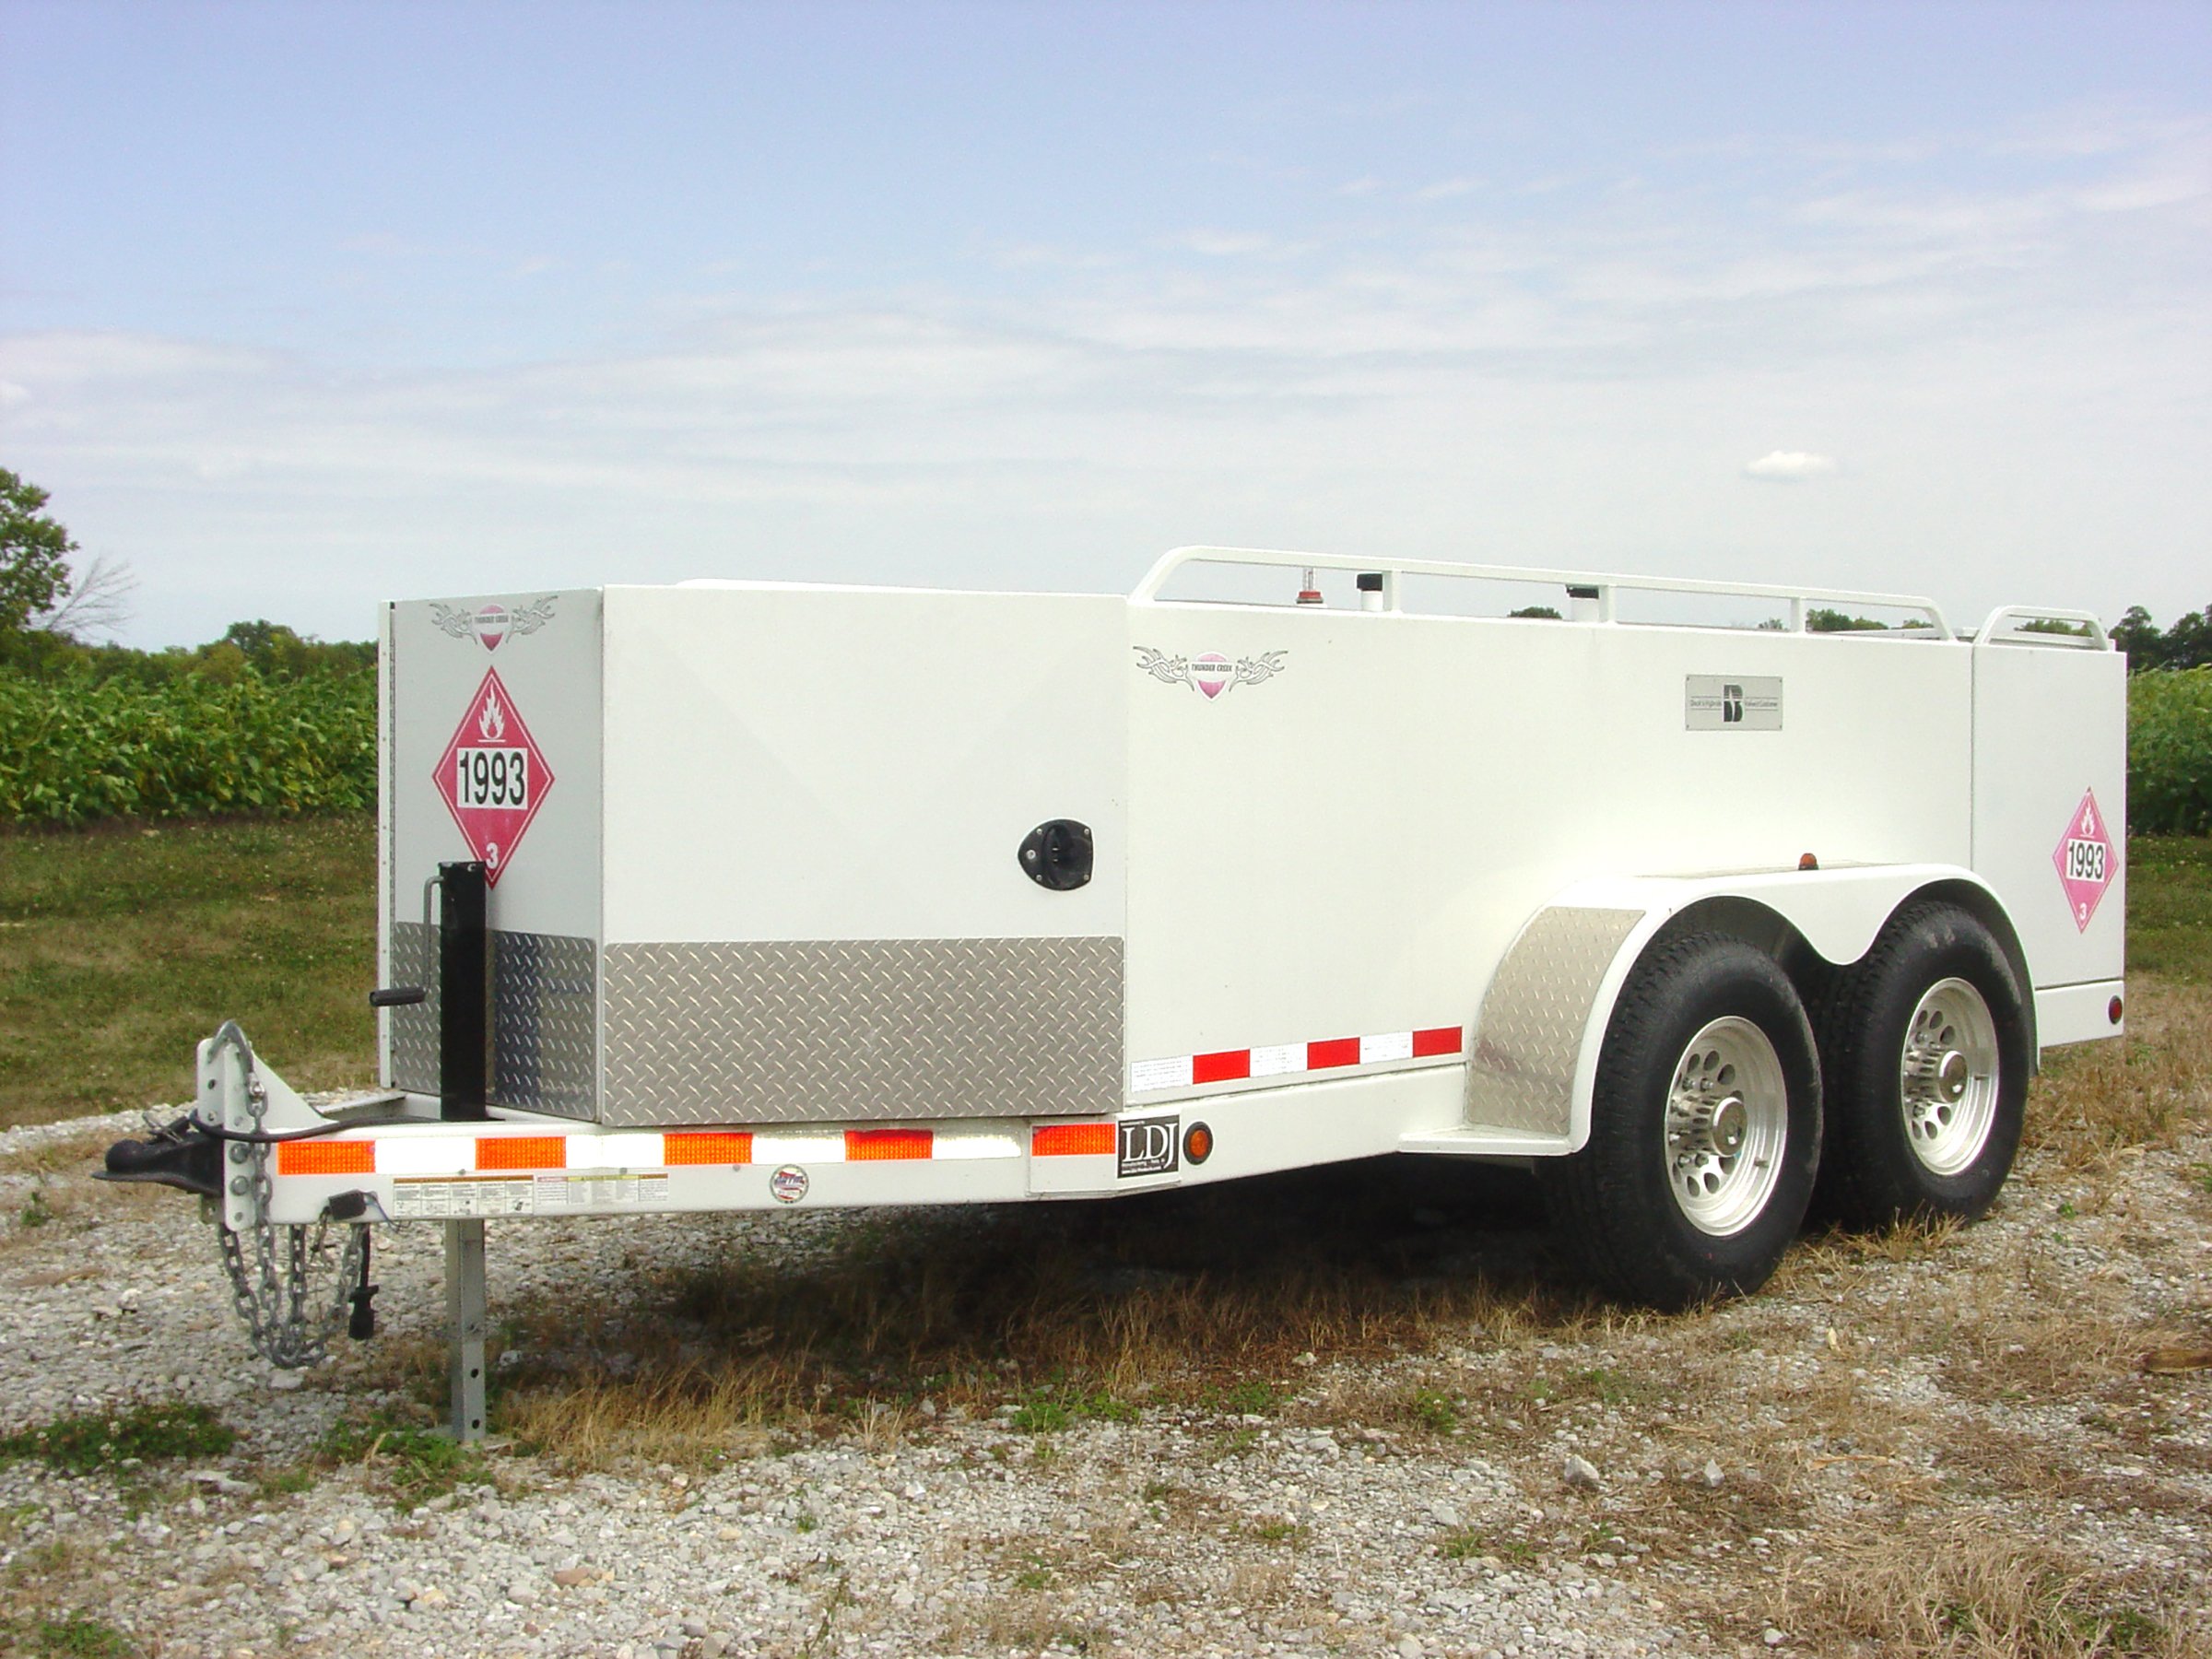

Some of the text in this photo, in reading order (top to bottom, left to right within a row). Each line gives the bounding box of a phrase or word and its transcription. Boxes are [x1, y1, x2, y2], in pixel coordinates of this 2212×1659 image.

[459, 750, 525, 806] 1993
[486, 842, 499, 870] 3
[2068, 841, 2105, 880] 1993
[2078, 902, 2088, 921] 3
[1122, 1123, 1179, 1170] LDJ
